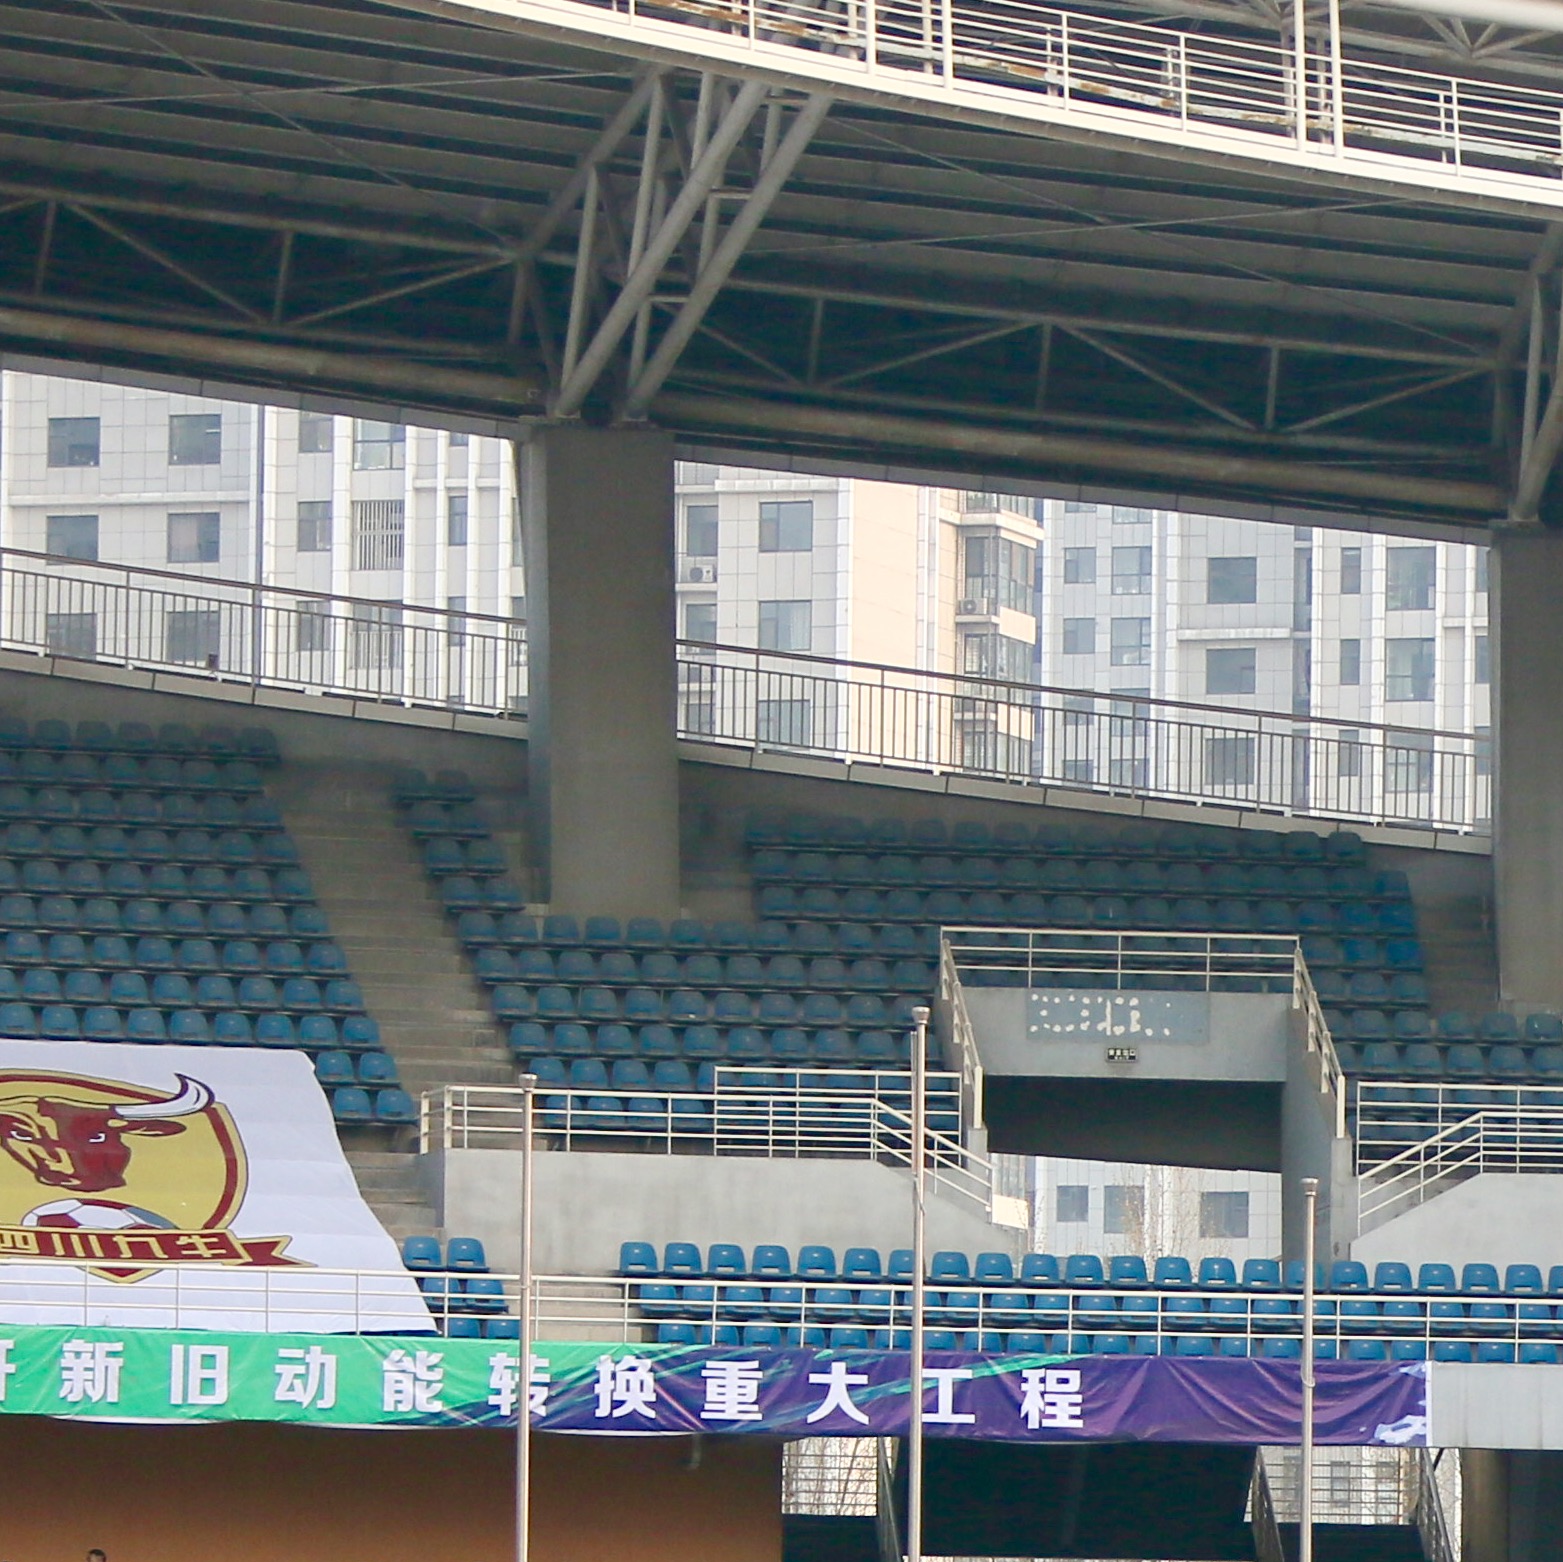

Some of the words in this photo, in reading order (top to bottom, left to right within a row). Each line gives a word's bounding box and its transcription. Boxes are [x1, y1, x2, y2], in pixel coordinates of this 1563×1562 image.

[0, 1338, 1085, 1431] 新旧动能转换重大工程
